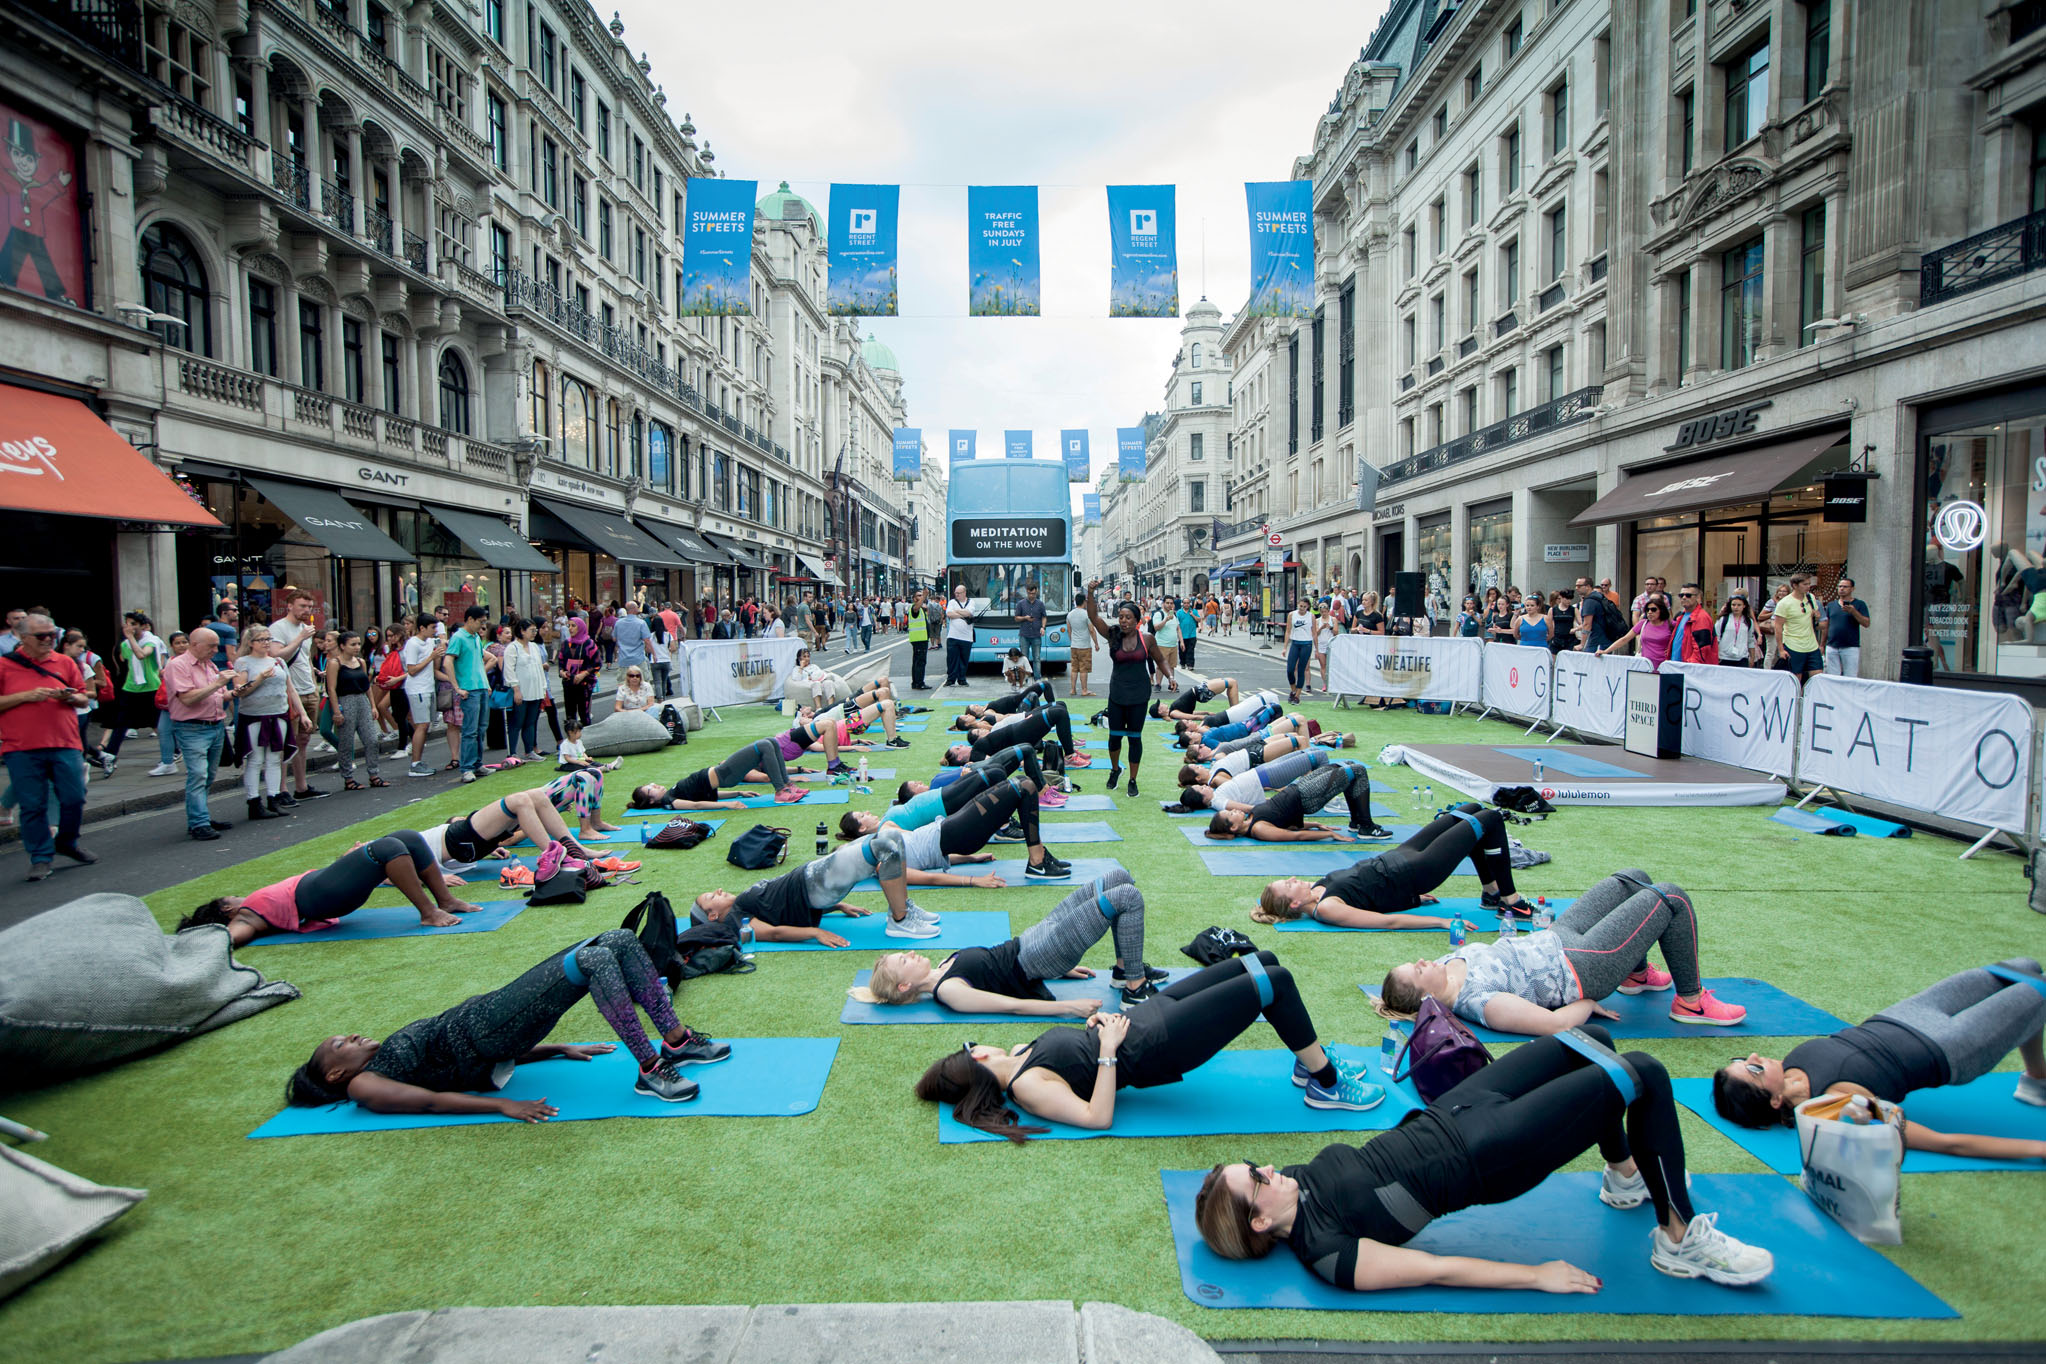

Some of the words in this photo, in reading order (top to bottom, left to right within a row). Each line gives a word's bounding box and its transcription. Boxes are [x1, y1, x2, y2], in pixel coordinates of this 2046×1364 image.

[692, 211, 746, 222] SUMMER
[984, 212, 1022, 220] TRAFFIC
[1256, 212, 1307, 222] SUMMER
[1662, 400, 1774, 452] BOSE
[0, 436, 64, 480] eys
[358, 468, 409, 486] GANT
[1644, 472, 1736, 497] BOSE
[1392, 504, 1404, 516] KORS
[304, 516, 364, 530] GANT
[970, 528, 1047, 537] MEDITATION
[480, 538, 515, 549] GANT
[214, 556, 263, 564] GANT
[1928, 629, 1950, 637] TICKETS
[1950, 630, 1968, 638] INSIDE
[1630, 700, 1656, 714] THIRD
[1631, 713, 1654, 726] SPACE
[1729, 692, 1929, 773] SWEAT
[1558, 790, 1610, 799] lululemon
